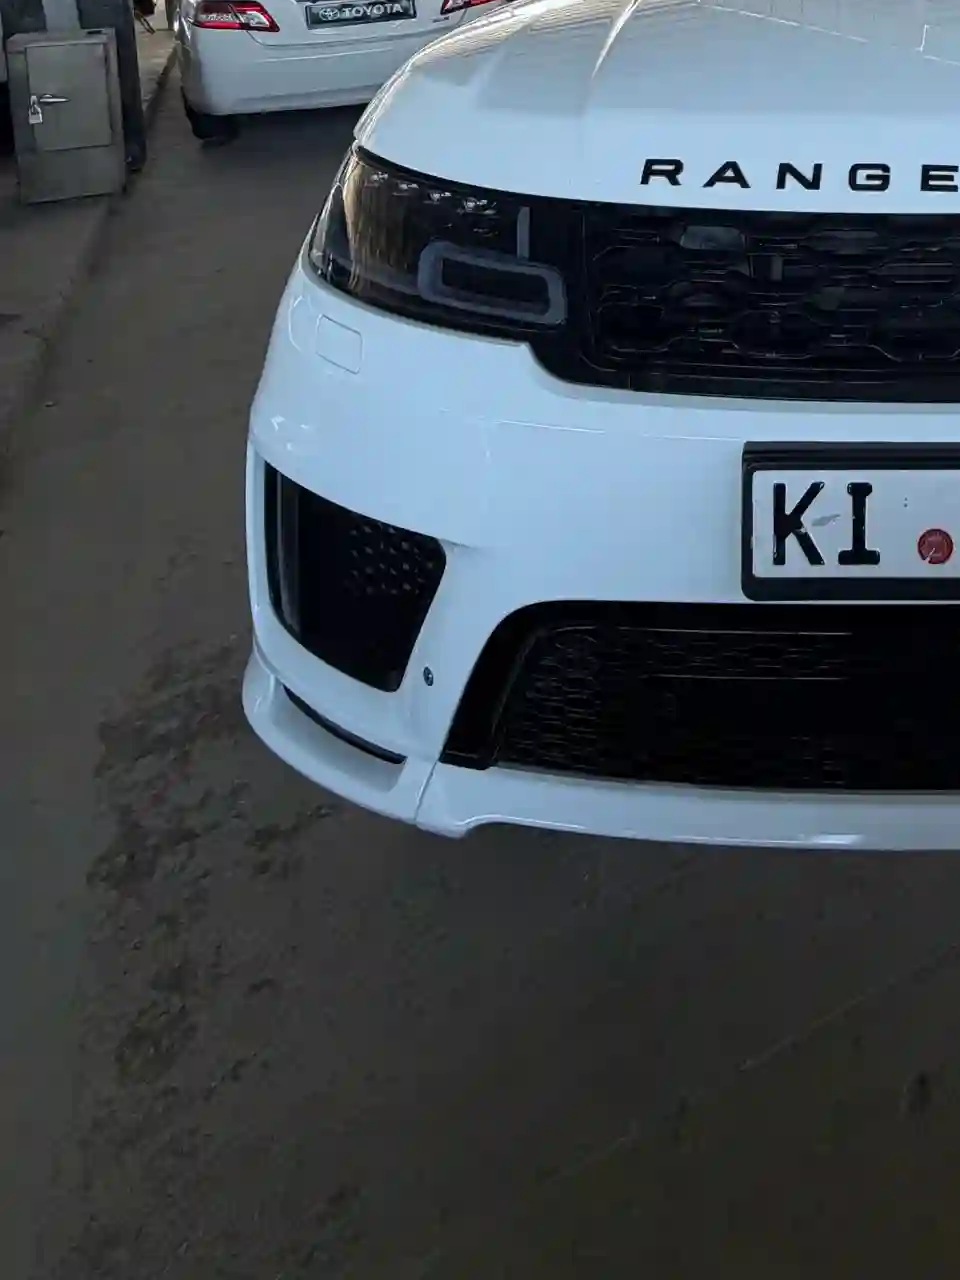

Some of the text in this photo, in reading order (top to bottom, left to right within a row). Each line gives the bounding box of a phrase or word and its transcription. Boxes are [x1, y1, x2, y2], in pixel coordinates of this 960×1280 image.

[342, 2, 403, 18] TOYOTA
[640, 158, 960, 193] RANGE
[771, 481, 881, 566] KI
